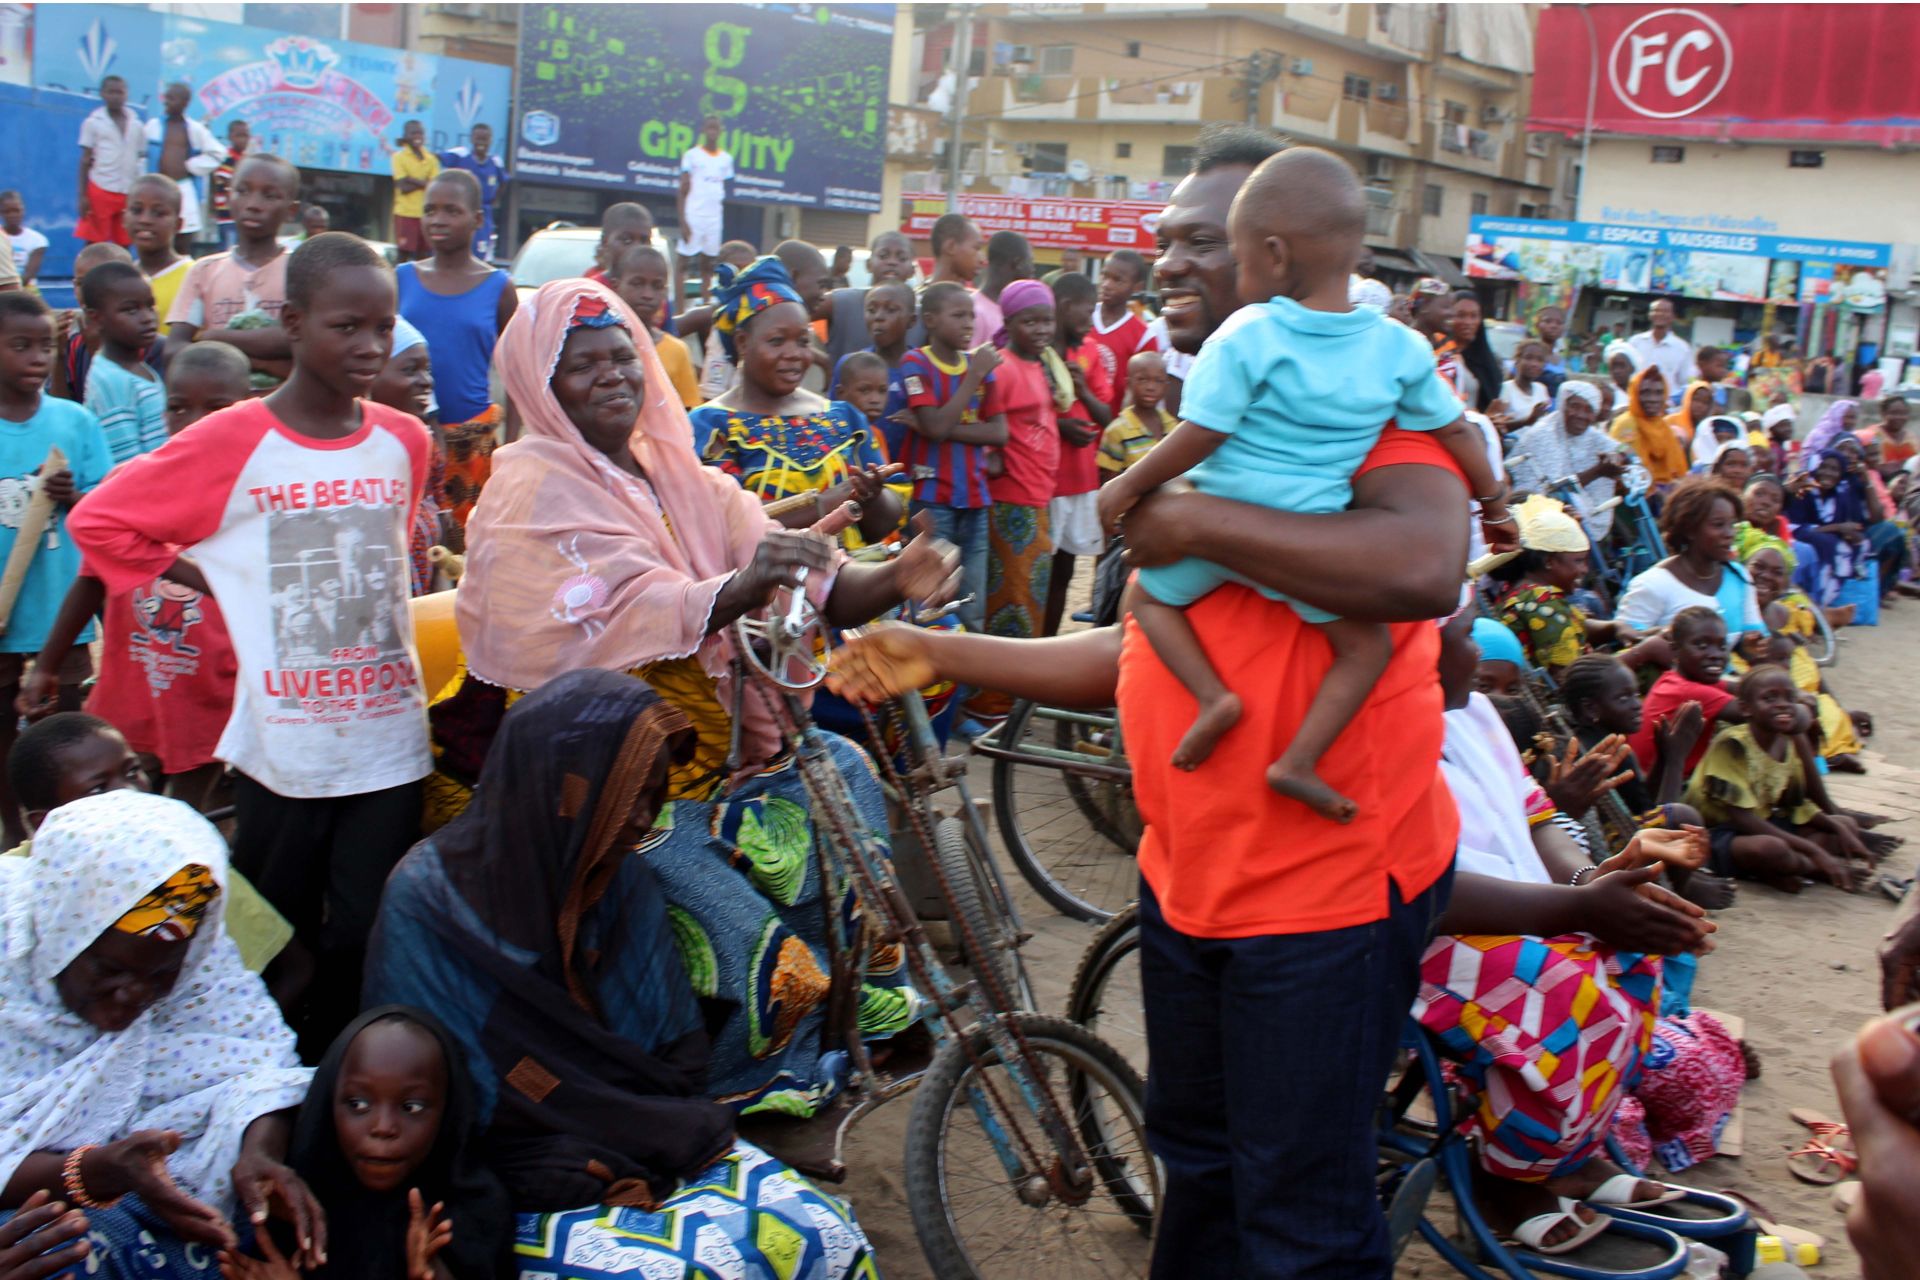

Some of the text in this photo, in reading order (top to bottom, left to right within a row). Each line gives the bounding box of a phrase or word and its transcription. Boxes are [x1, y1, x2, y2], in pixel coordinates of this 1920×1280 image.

[704, 23, 752, 118] g
[1627, 31, 1714, 97] FC
[640, 119, 796, 174] GRVITY
[1602, 228, 1758, 252] ESPACE VAISSELLES
[249, 483, 307, 513] THE
[332, 646, 379, 661] FROM
[303, 701, 324, 714] TO
[327, 699, 358, 712] THE
